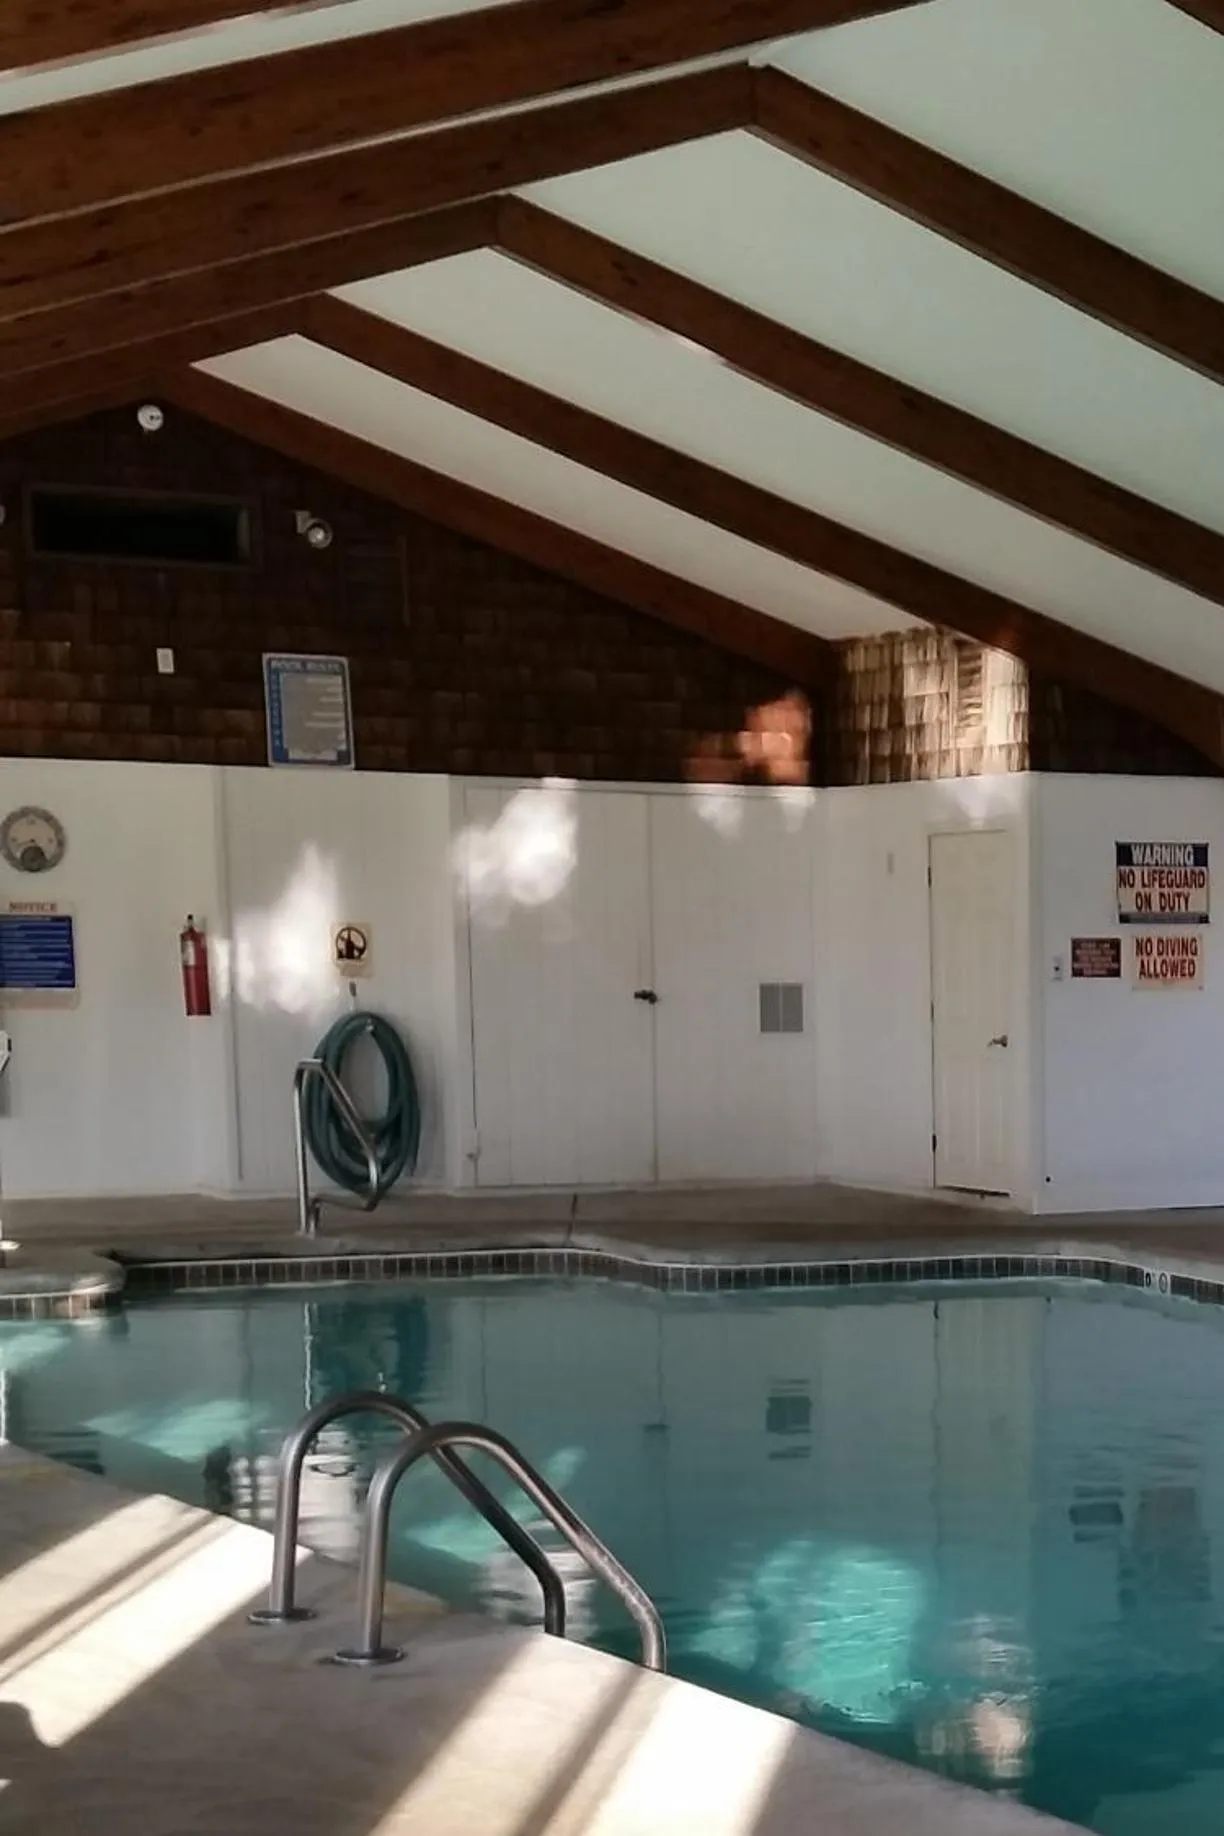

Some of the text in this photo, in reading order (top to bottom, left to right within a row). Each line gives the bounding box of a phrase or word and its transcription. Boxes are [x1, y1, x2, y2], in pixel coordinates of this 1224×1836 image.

[1131, 843, 1194, 865] WARNING
[1119, 869, 1205, 889] NO LIFEGUARD
[9, 902, 58, 914] NOTICE
[1135, 892, 1191, 912] ON DUTY
[1135, 937, 1198, 957] NO DIVING
[1139, 959, 1196, 979] ALLOWED
